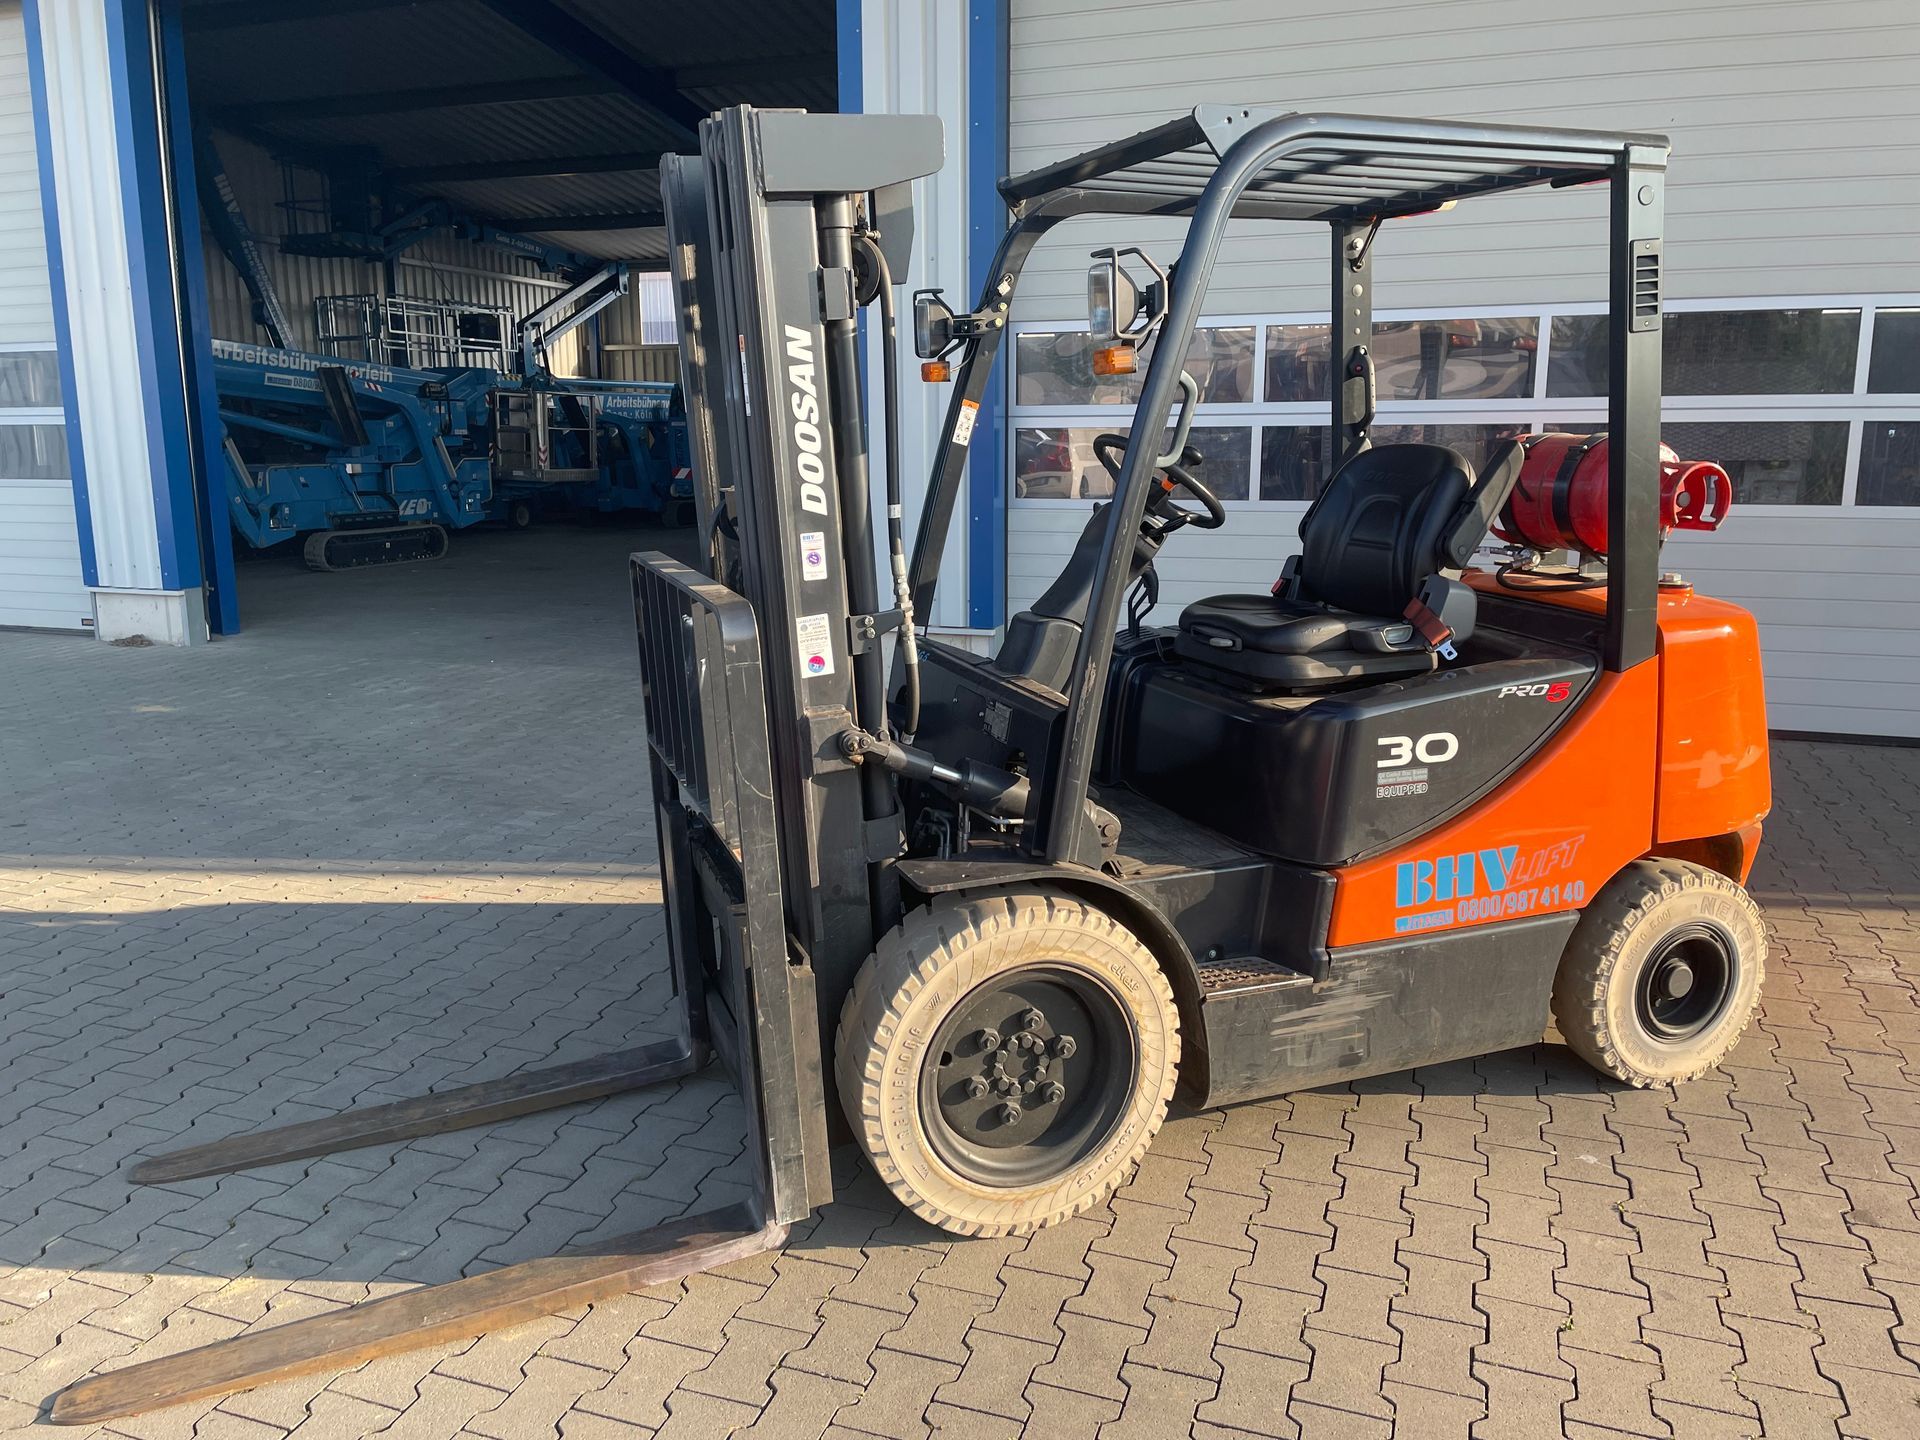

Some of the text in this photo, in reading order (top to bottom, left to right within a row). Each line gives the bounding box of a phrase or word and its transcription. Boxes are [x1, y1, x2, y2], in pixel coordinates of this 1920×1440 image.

[785, 324, 828, 516] DOOSAN
[1498, 682, 1572, 703] PRO5
[1377, 732, 1459, 768] 30
[1376, 782, 1428, 798] EQUIPPED
[1396, 834, 1585, 908] BHV LIFT
[1700, 895, 1755, 970] NEXEN
[891, 1026, 923, 1152] TRELLEBORG
